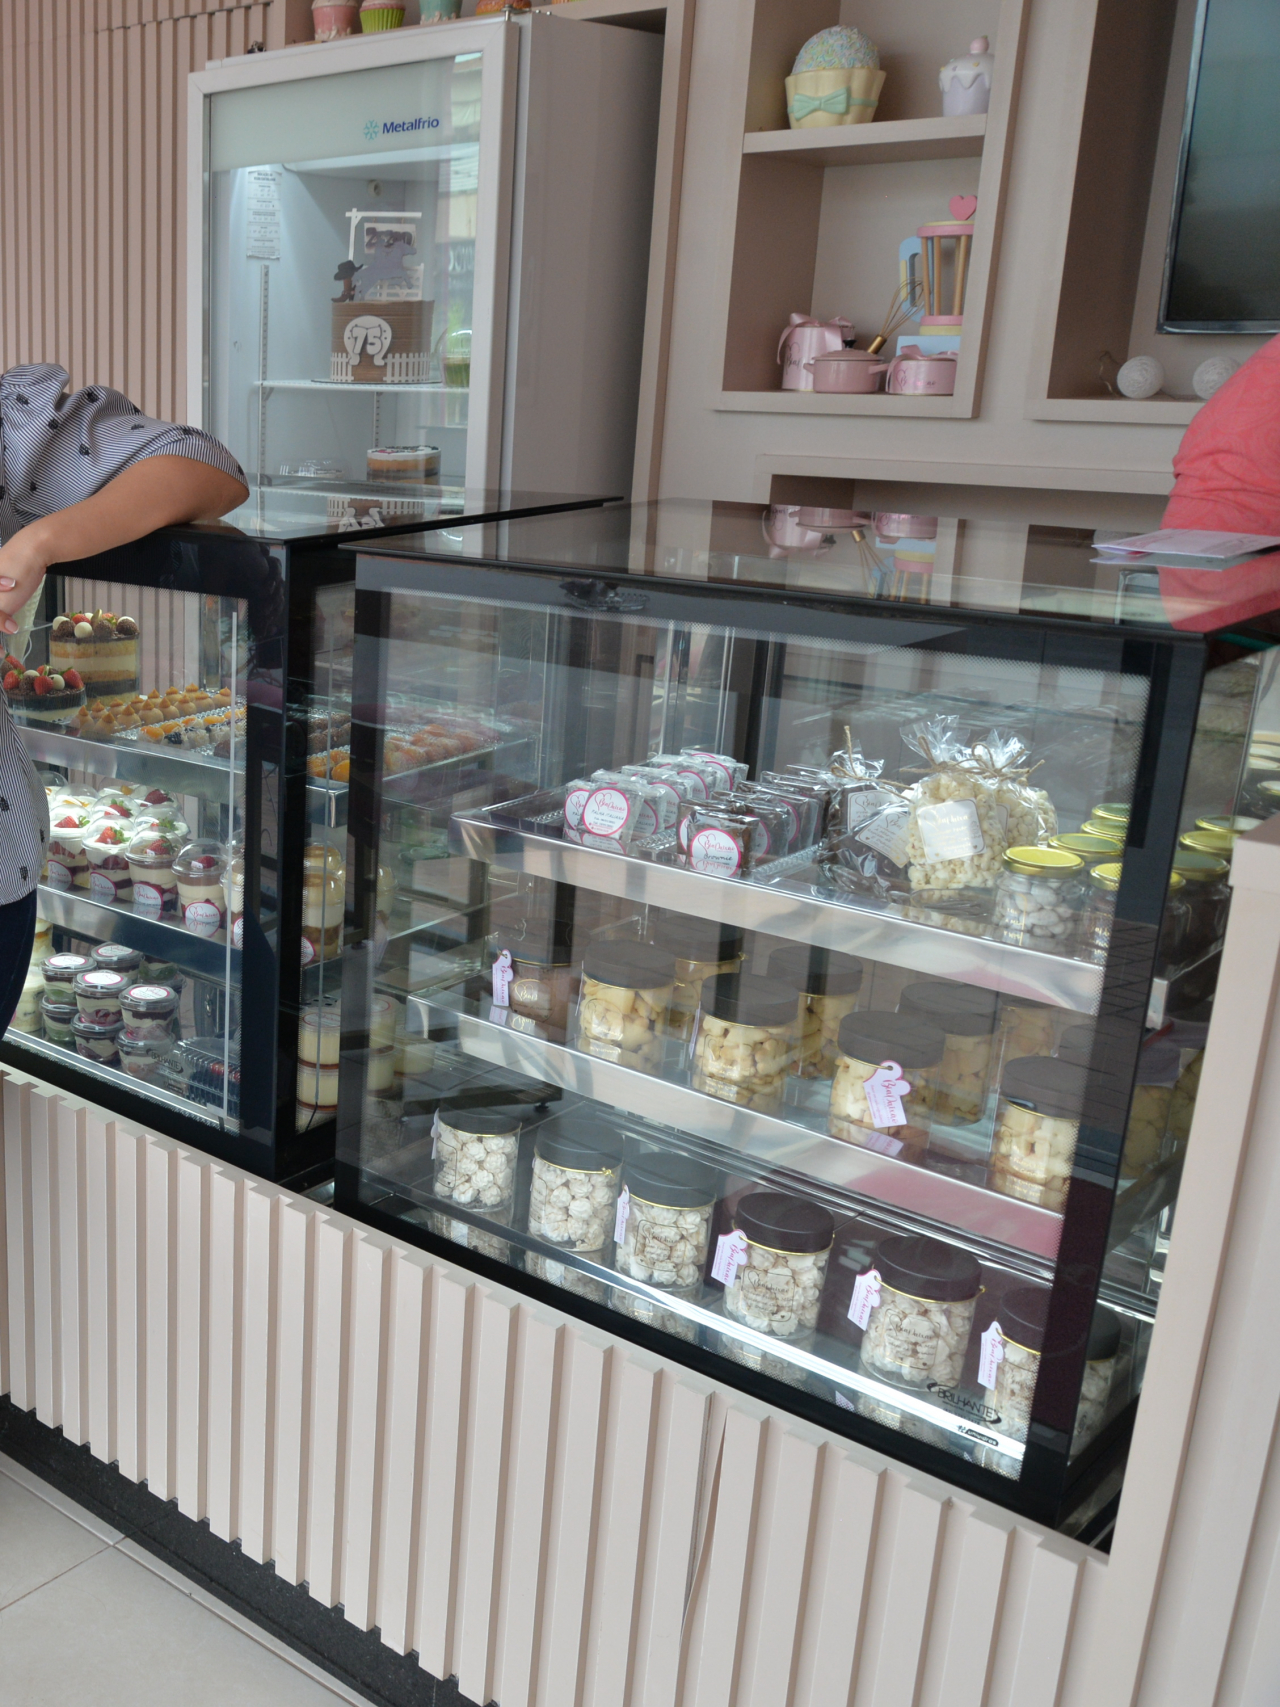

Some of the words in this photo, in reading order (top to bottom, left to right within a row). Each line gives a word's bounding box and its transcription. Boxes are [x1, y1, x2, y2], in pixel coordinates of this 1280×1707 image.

[382, 117, 440, 134] Metalfrio
[351, 325, 382, 355] 75
[938, 1387, 994, 1419] BRILHANTE
